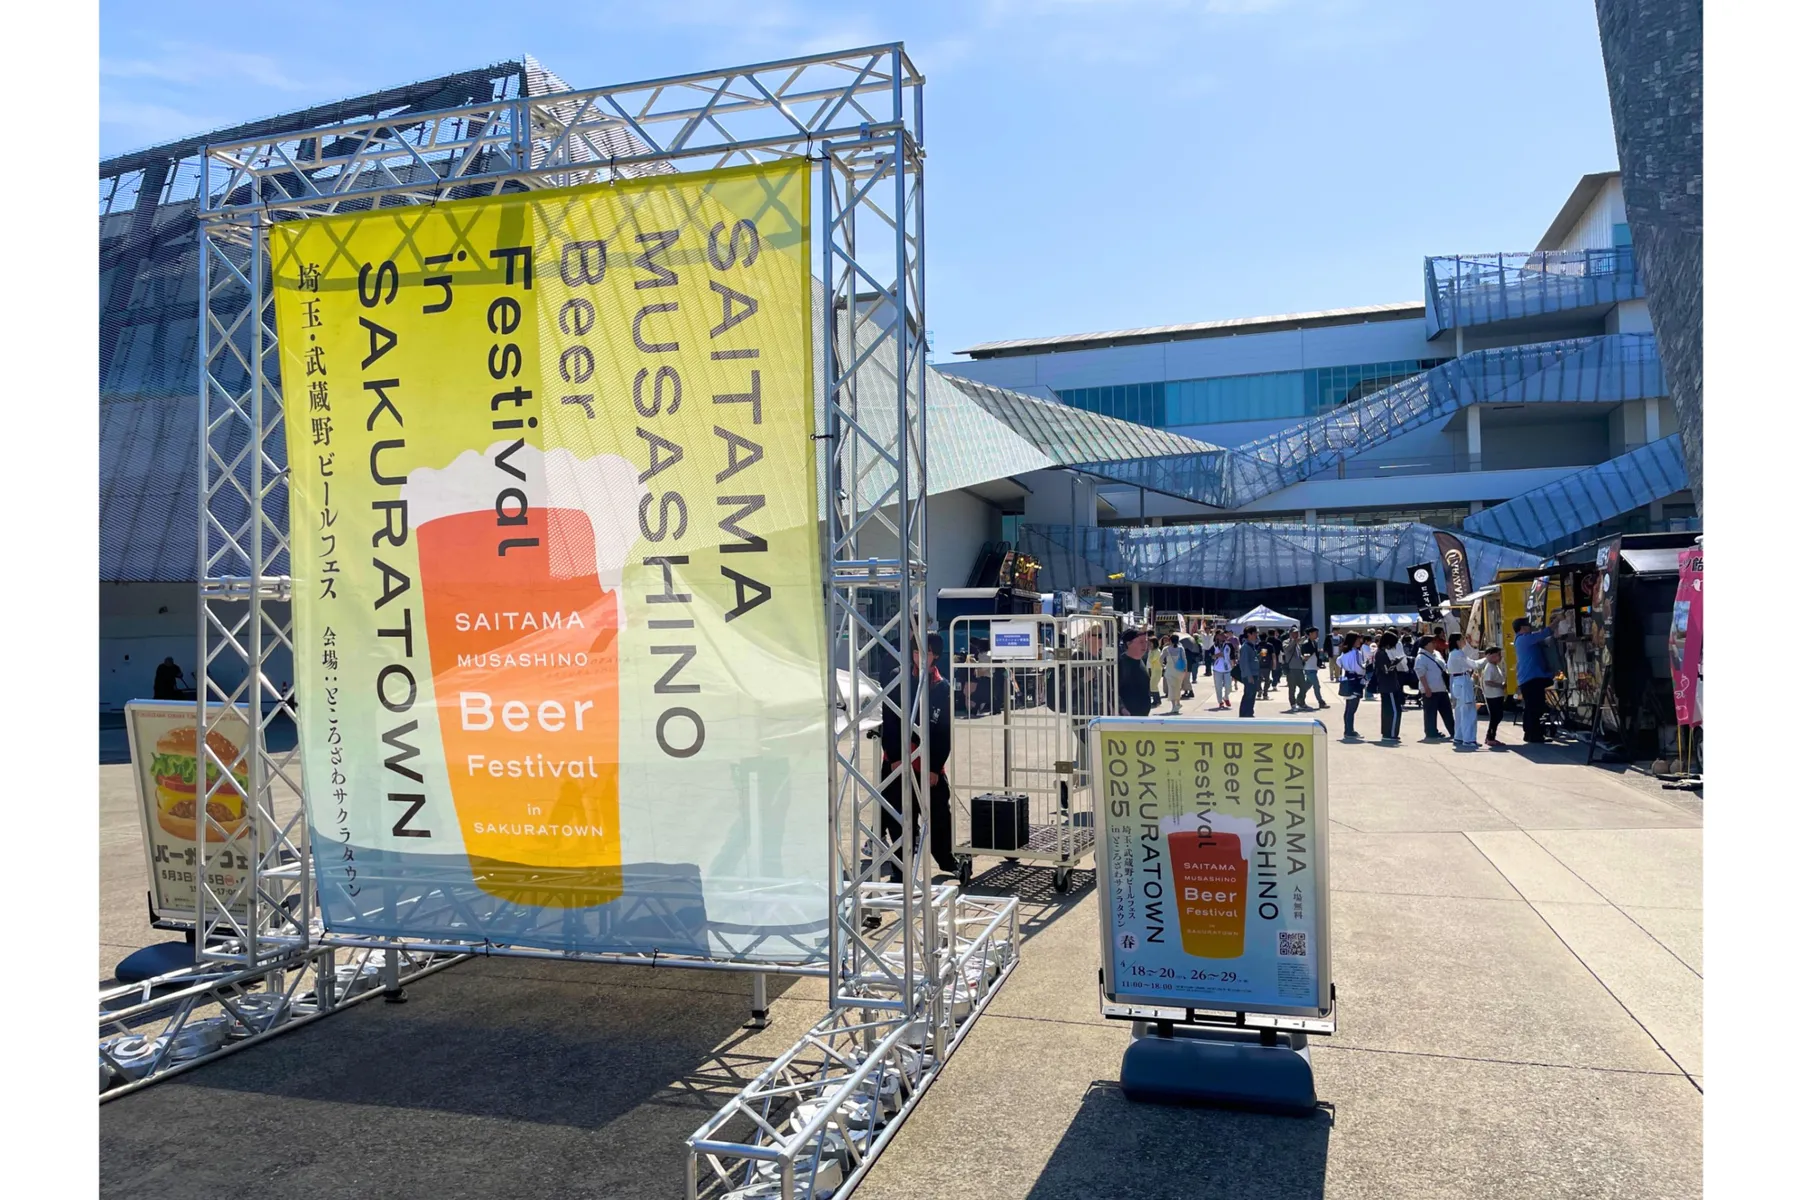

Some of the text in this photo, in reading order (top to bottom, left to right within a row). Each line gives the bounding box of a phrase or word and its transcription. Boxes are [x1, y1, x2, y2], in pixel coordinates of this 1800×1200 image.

[422, 249, 467, 314] in
[558, 238, 607, 420] Beer
[486, 245, 540, 557] Festival
[706, 218, 772, 623] SAITAMA
[630, 229, 706, 759] MUSASHINO
[357, 259, 432, 839] SAKURATOWN
[455, 611, 585, 632] SAITAMA
[457, 652, 588, 668] MUSASHINO
[459, 691, 594, 732] Beer
[467, 753, 599, 779] Festival
[1164, 739, 1185, 763] in
[1223, 741, 1243, 806] Beer
[1107, 739, 1130, 818] 2025
[1193, 741, 1217, 849] Festival
[473, 822, 603, 838] SAKURATOWN
[527, 804, 541, 816] in
[1253, 742, 1279, 921] MUSASHINO
[1283, 741, 1307, 876] SAITAMA
[1135, 739, 1165, 944] SAKURATOWN
[1183, 862, 1236, 871] SAITAMA
[1184, 875, 1237, 883] MUSASHINO
[1184, 887, 1237, 903] Beer
[1186, 907, 1238, 918] Festival
[1121, 935, 1135, 949] 春
